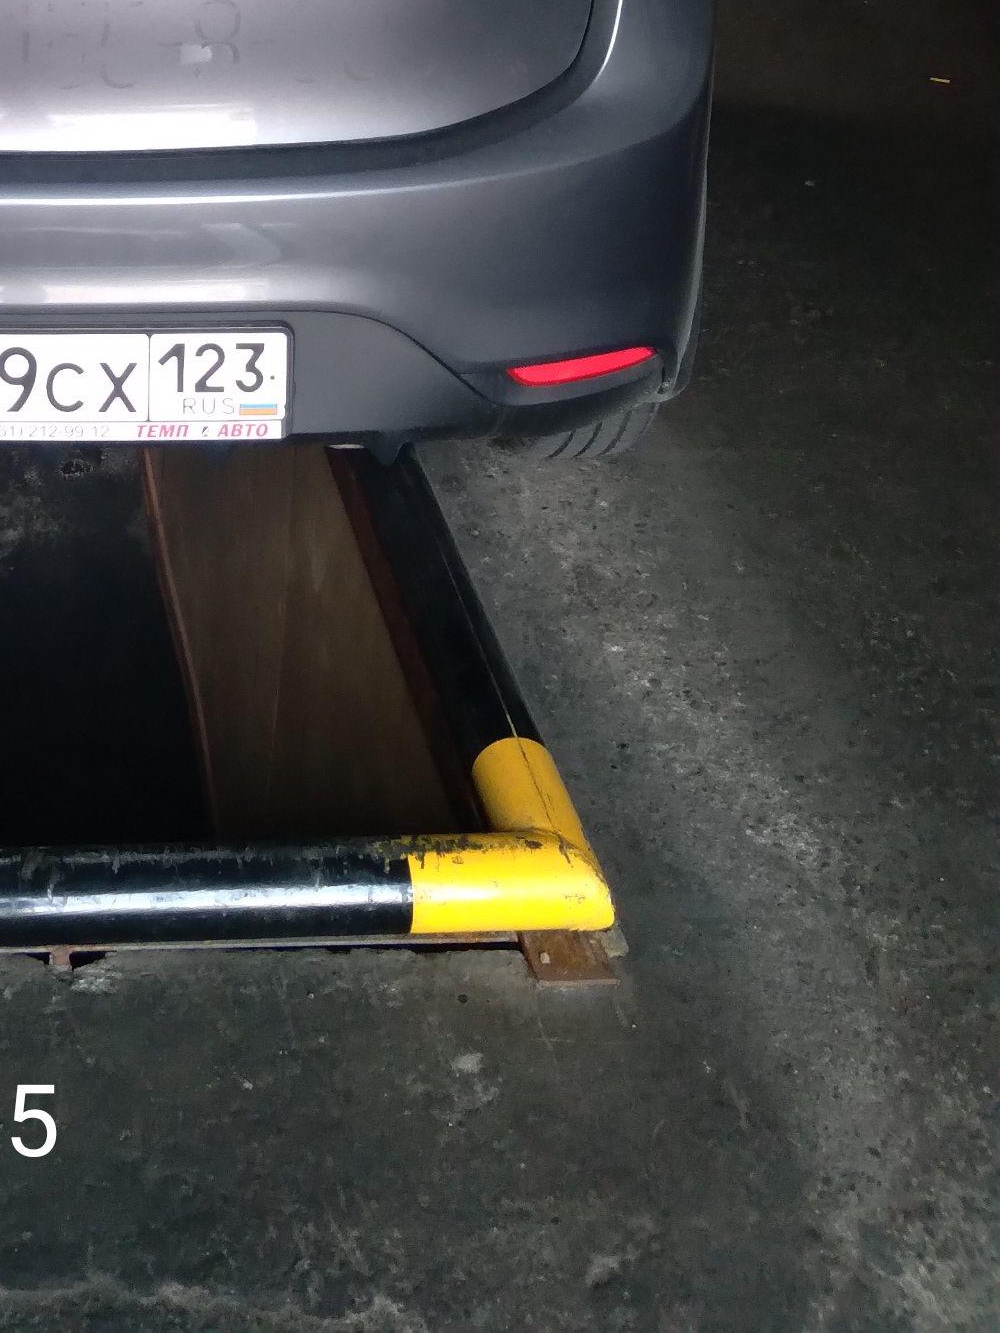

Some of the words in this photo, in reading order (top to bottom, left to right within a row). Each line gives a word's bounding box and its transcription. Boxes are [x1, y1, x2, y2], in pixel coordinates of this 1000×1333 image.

[158, 343, 265, 393] 123
[182, 397, 236, 415] RUS
[136, 424, 190, 438] ТЕМП
[216, 423, 269, 438] АВТО
